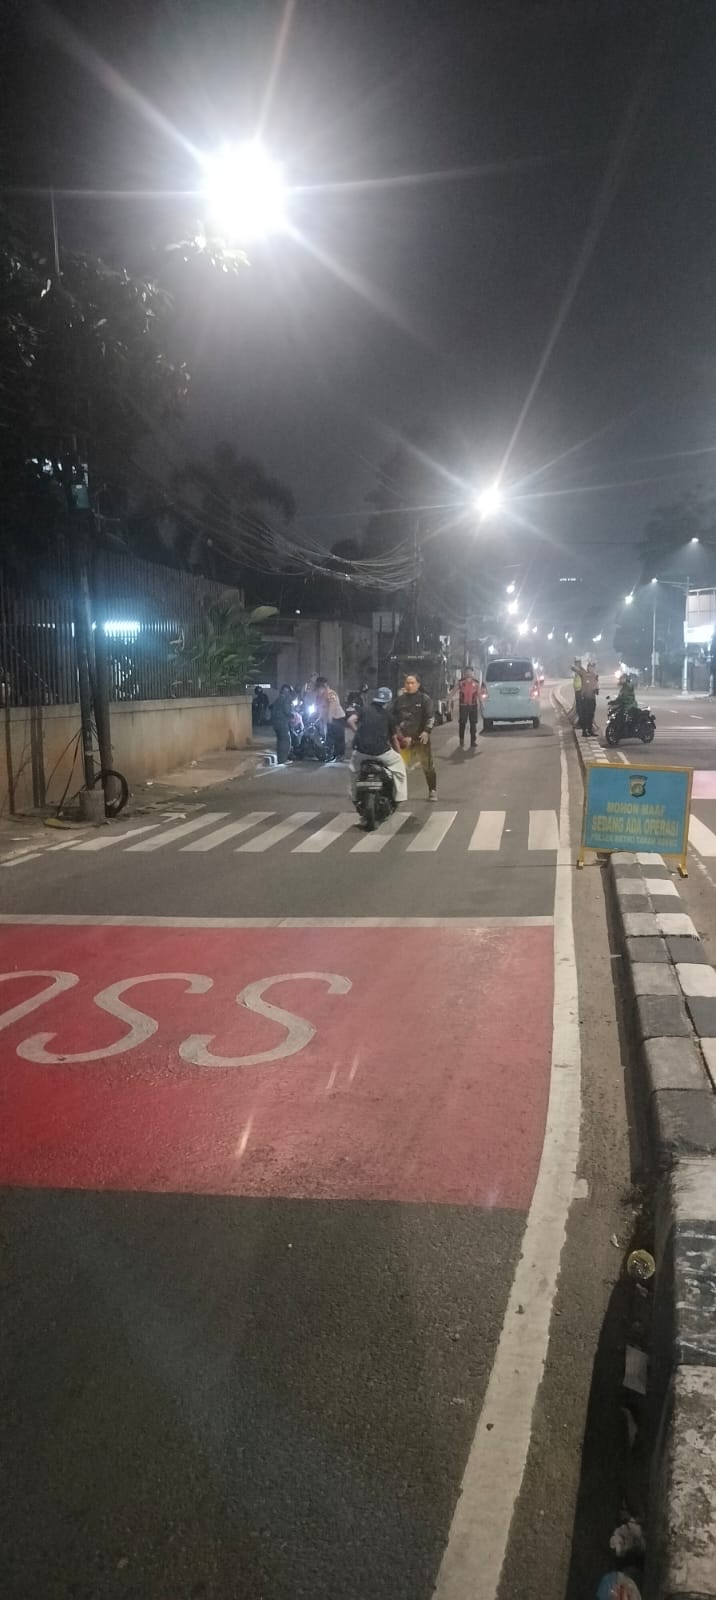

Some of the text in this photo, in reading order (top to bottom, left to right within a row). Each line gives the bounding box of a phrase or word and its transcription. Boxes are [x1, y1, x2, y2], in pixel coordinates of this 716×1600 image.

[607, 801, 665, 816] MOHON MAAF
[592, 815, 679, 837] SEDANG ADA OPERASI
